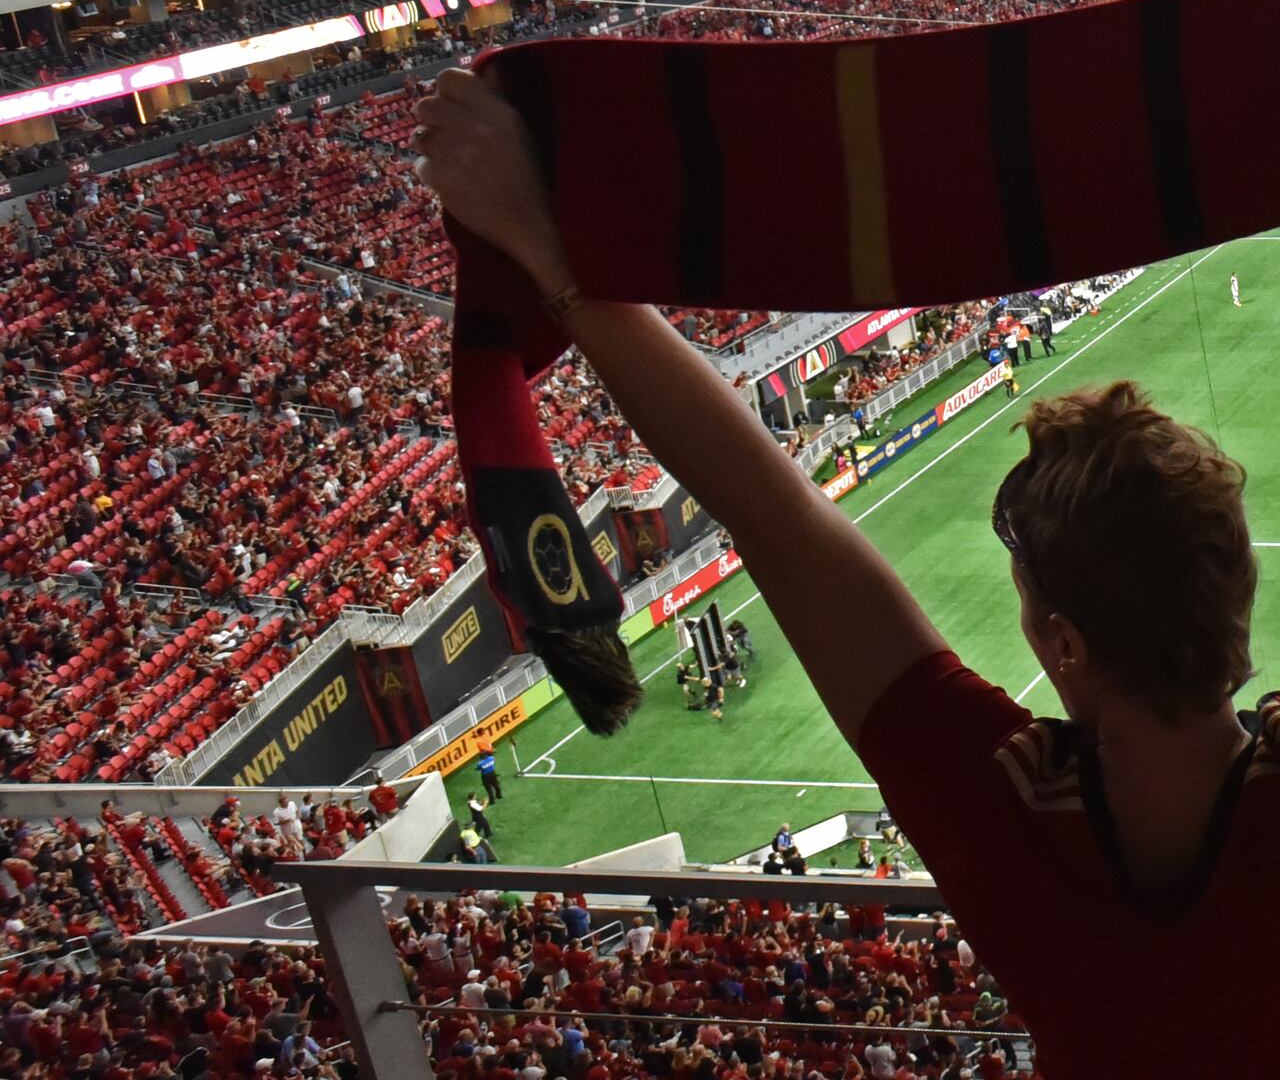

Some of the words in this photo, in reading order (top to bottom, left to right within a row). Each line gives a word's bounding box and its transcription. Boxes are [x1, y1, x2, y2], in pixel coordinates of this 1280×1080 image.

[317, 94, 332, 107] 127
[944, 367, 1004, 414] ADVOCARE
[447, 615, 478, 658] UNITE
[283, 675, 348, 752] UNITED
[485, 706, 521, 737] TIRE
